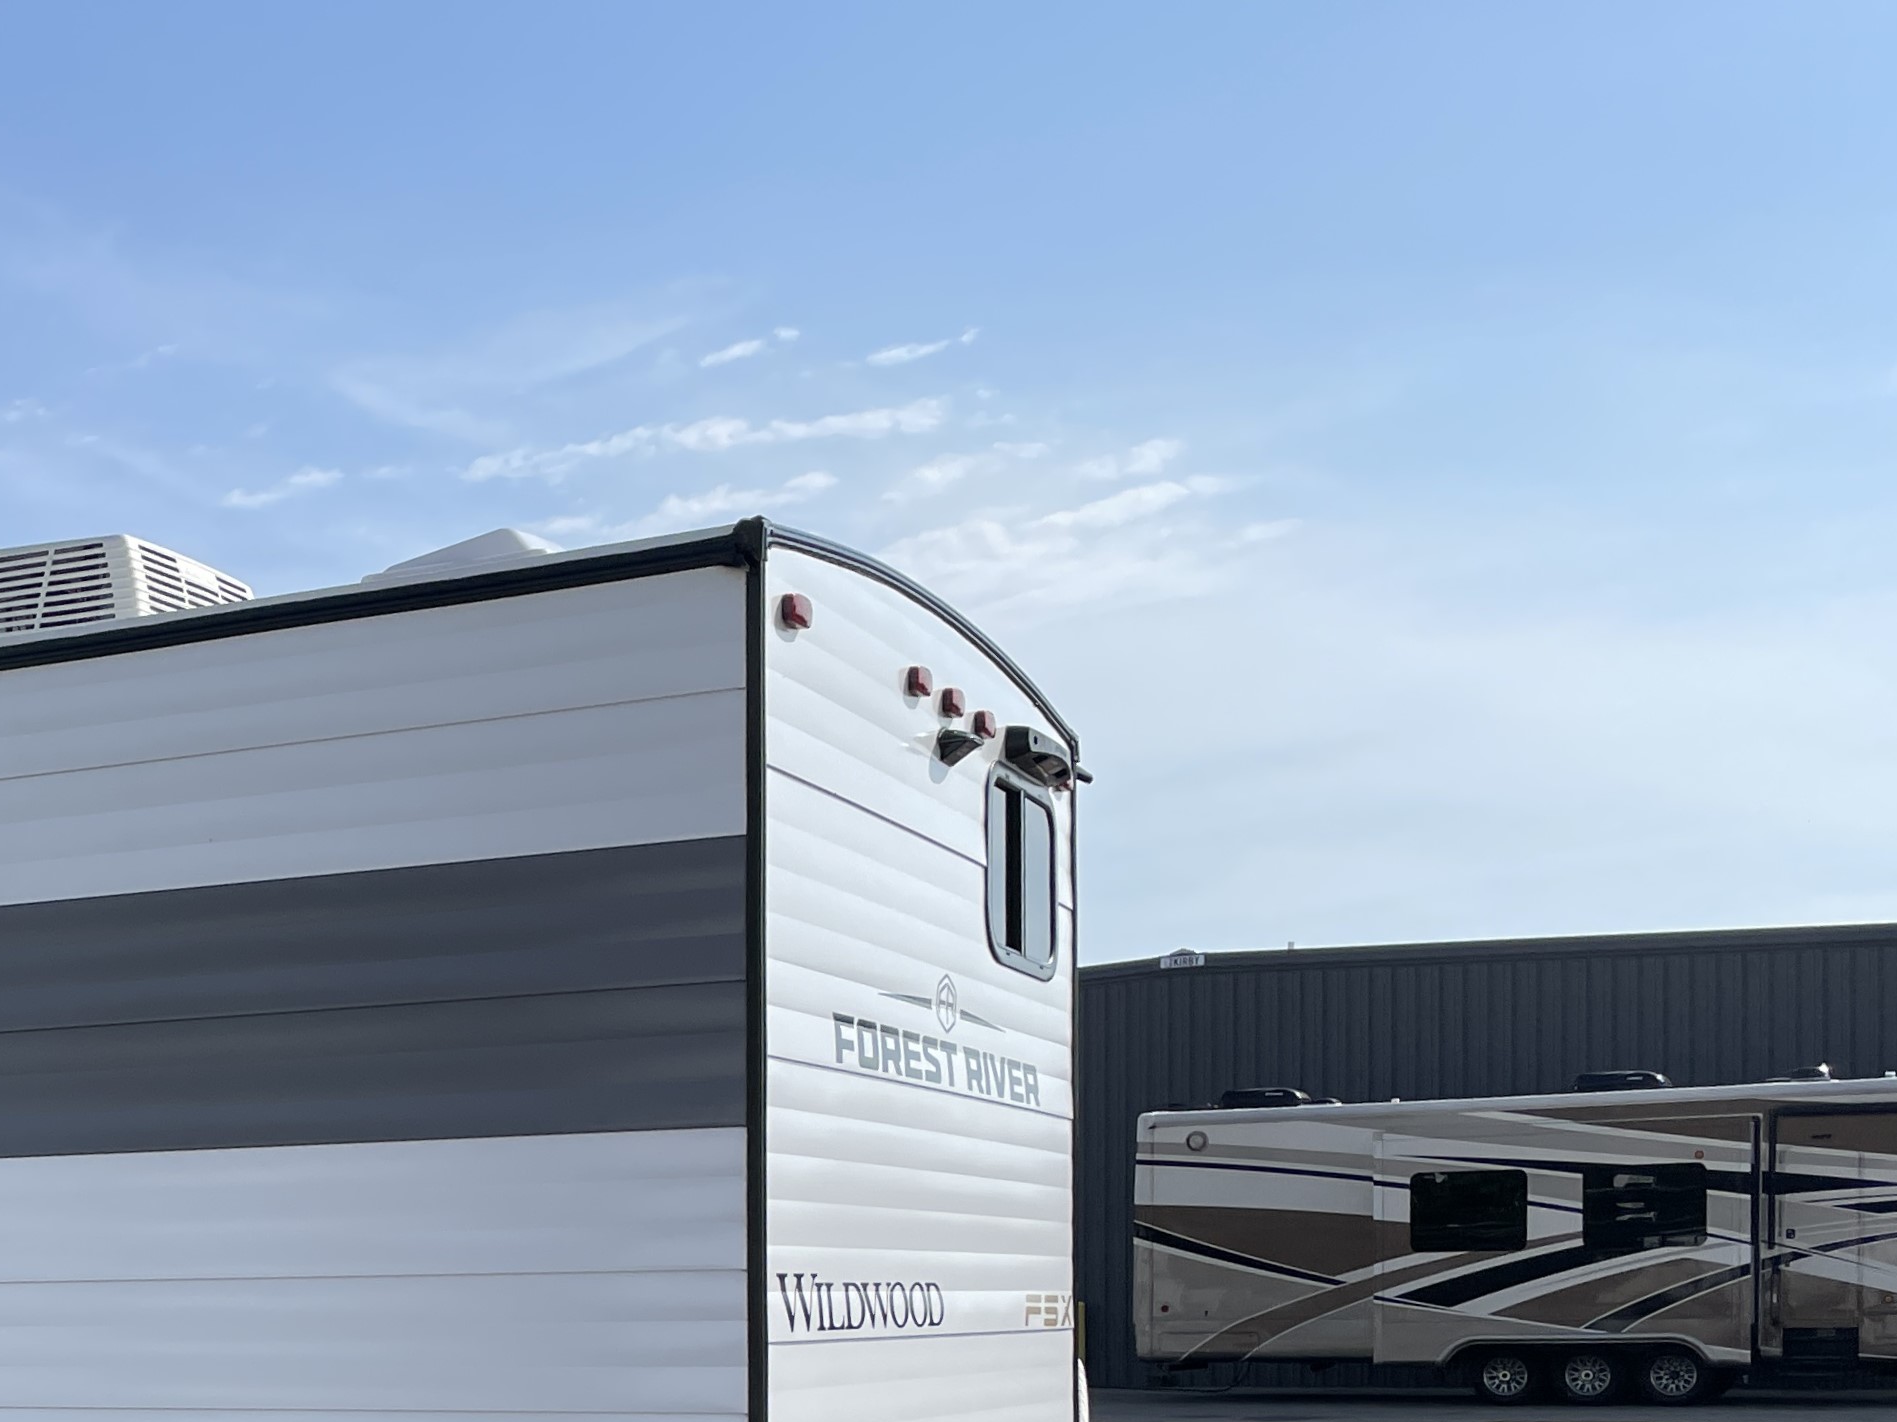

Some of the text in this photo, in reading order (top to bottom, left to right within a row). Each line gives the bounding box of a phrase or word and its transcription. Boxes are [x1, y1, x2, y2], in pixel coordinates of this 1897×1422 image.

[833, 1011, 1041, 1107] FOREST RIVER
[776, 1272, 1073, 1332] WILDWOOD FSX
